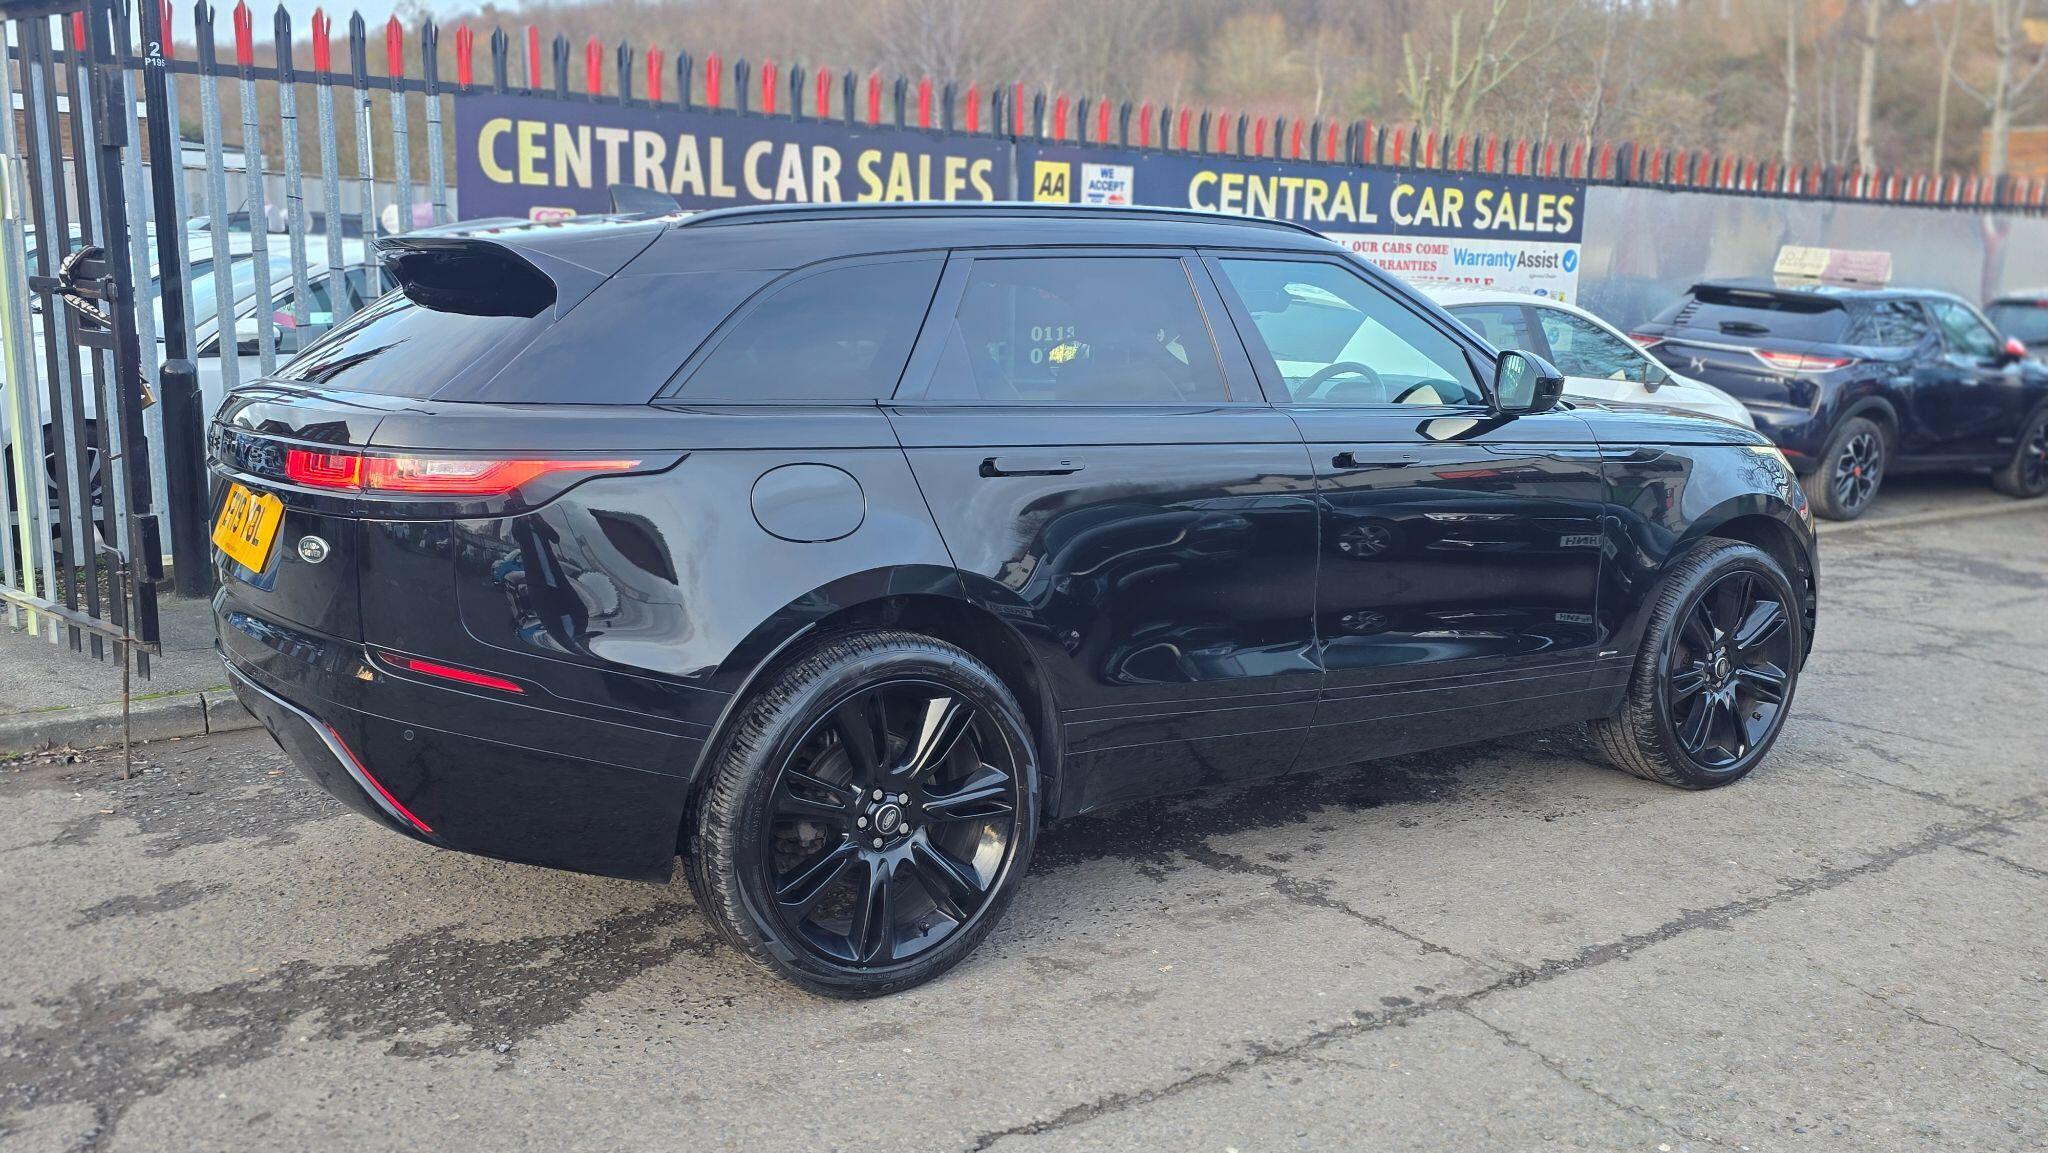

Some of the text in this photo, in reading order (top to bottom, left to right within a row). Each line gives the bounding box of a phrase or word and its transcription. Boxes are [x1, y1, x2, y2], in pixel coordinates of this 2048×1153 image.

[149, 41, 160, 57] 2
[478, 118, 993, 203] CENTRAL CAR SALES
[1100, 168, 1114, 179] WE
[1038, 172, 1065, 196] AA
[1088, 180, 1125, 191] ACCEPT
[1189, 171, 1575, 234] CENTRAL CAR SALES
[1353, 240, 1378, 252] OUR
[1382, 241, 1412, 254] CARS
[1416, 243, 1449, 255] COME
